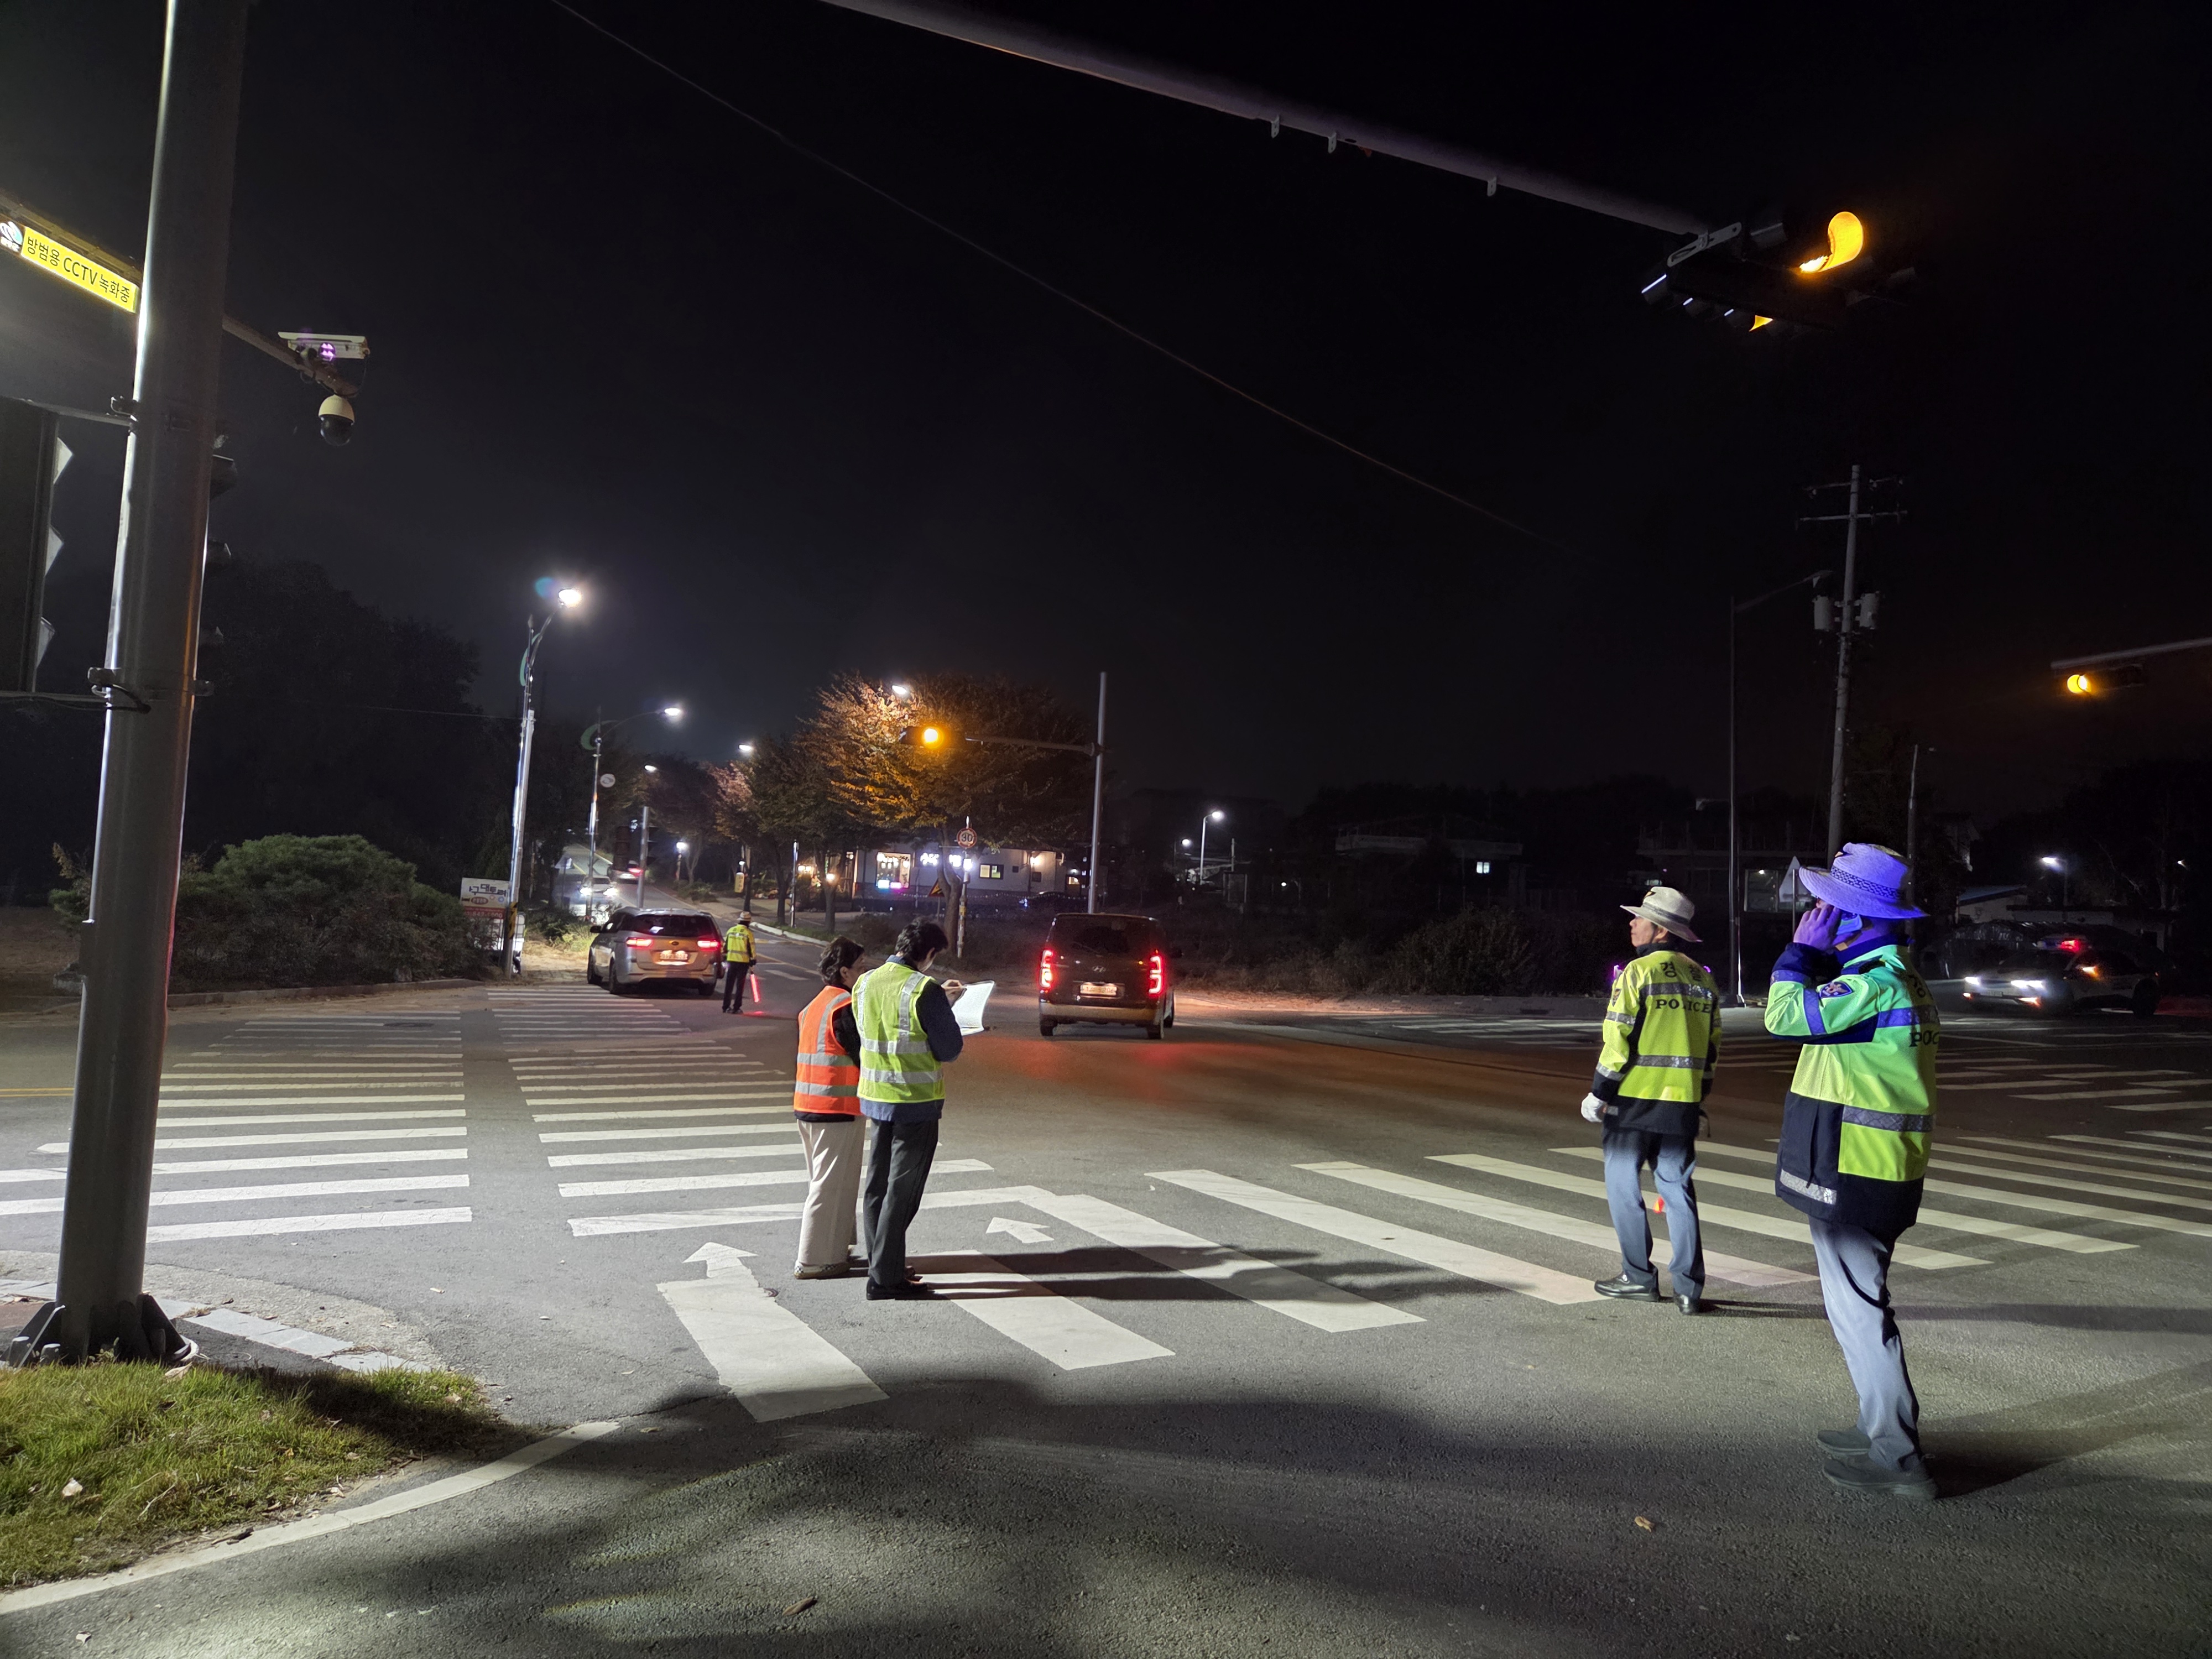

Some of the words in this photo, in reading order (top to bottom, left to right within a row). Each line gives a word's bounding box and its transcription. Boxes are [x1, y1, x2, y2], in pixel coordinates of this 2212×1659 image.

[28, 236, 60, 267] 방범용
[64, 257, 97, 285] CCTV
[99, 274, 130, 303] 녹화중
[962, 832, 973, 842] 30
[1655, 998, 1712, 1013] POICE
